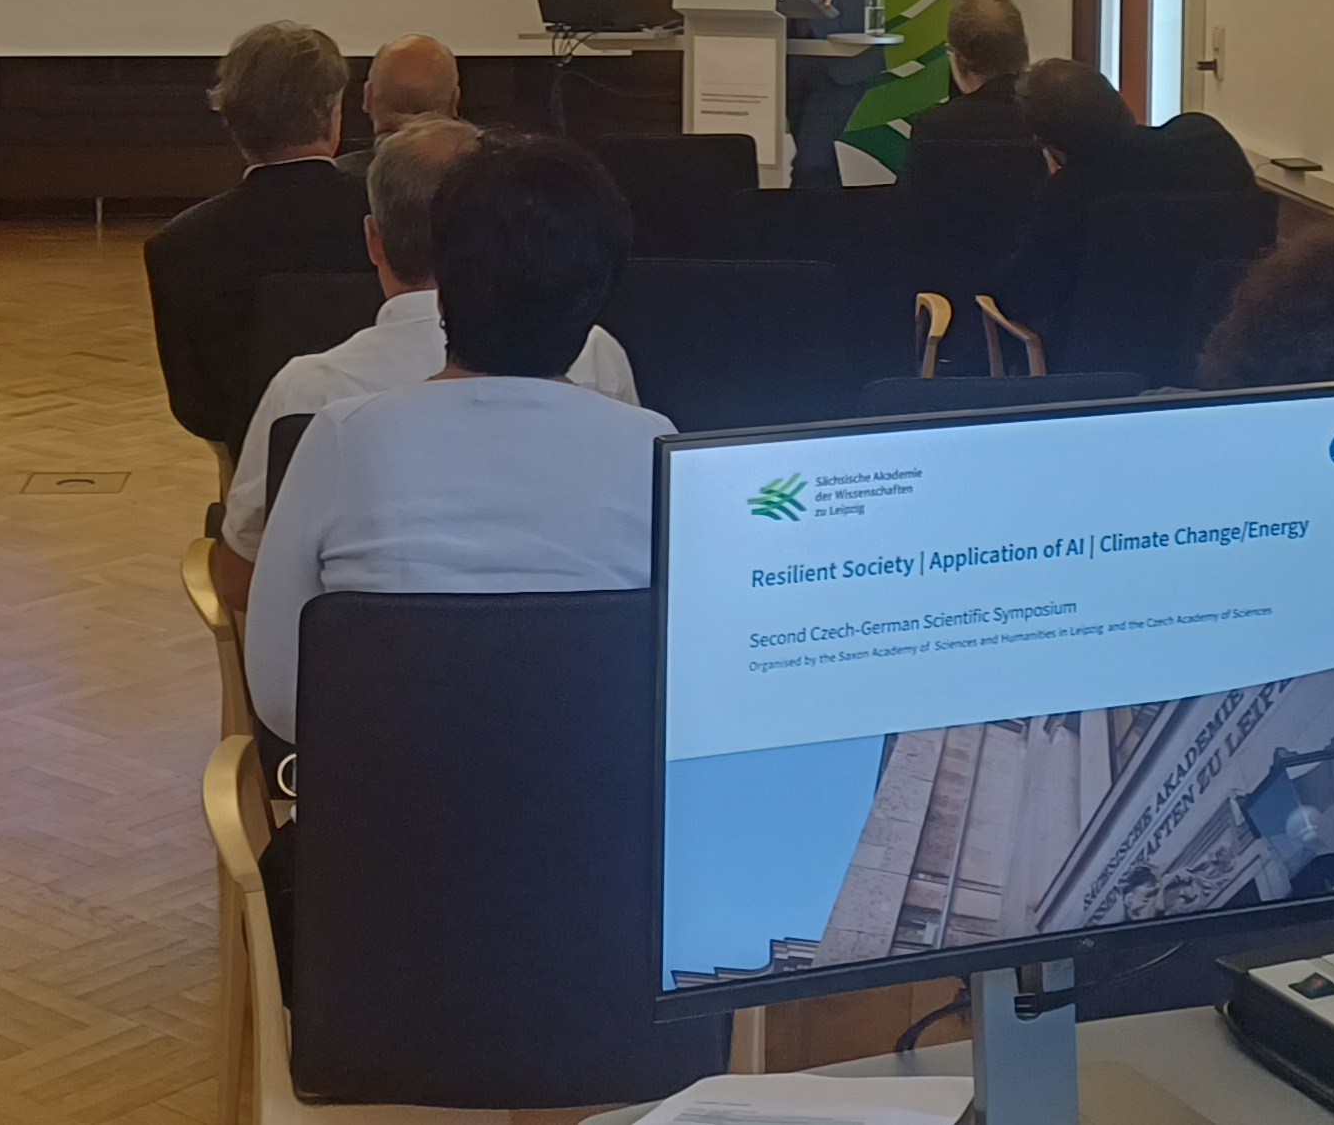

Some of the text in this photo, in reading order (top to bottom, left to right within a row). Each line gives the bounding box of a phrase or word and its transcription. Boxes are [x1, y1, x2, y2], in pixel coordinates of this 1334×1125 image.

[815, 467, 923, 487] Sächsische Akademie
[815, 484, 914, 503] der Wissenschaften
[815, 503, 866, 517] zu Leipzig
[751, 562, 837, 588] Resilient
[842, 556, 915, 579] Society
[929, 543, 1038, 573] Application
[1043, 539, 1064, 559] of
[1065, 538, 1085, 557] AI
[1100, 531, 1170, 553] Climate
[1174, 520, 1309, 547] Change/Energy
[749, 601, 1077, 649] Second Czech-German Scientific Symposium
[749, 606, 1273, 673] Organised by the Saxon Academy of Sciences and Humanities in Leipzig and the Czech Academy of Sciences
[1154, 689, 1244, 813] AKADEMIE
[1196, 748, 1223, 795] ZU
